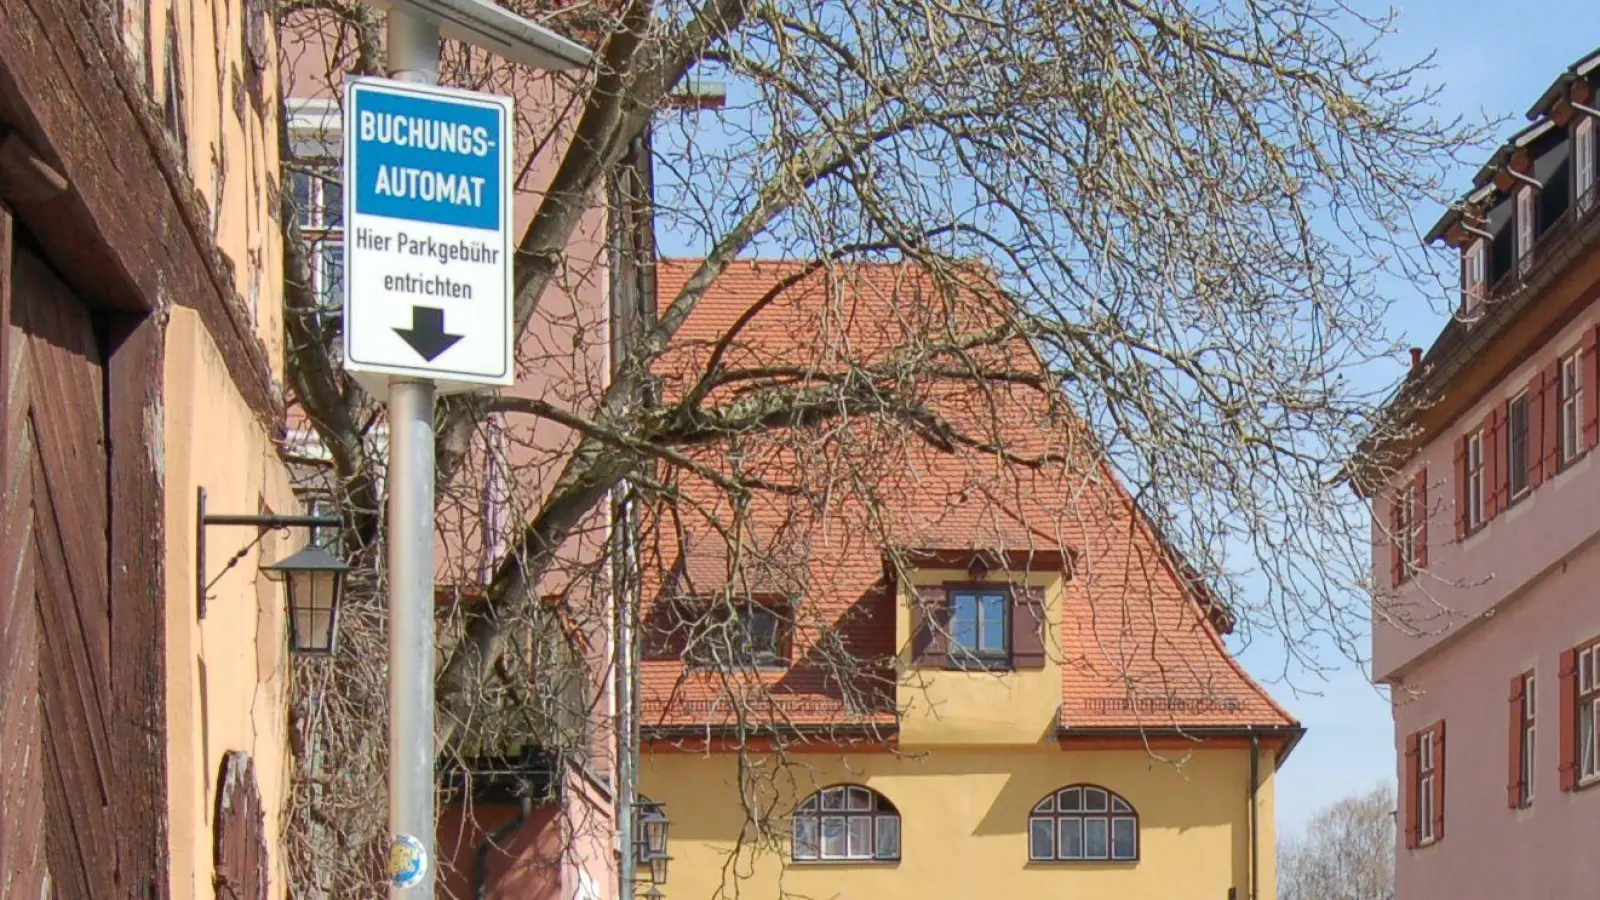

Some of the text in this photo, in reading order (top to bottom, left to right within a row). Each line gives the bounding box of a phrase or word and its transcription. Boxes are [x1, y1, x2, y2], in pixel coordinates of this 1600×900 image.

[360, 110, 496, 157] BUCHUNGS-
[375, 164, 485, 207] AUTOMAT
[356, 227, 499, 265] Hier Parkgebühr
[384, 273, 472, 299] entrichten
